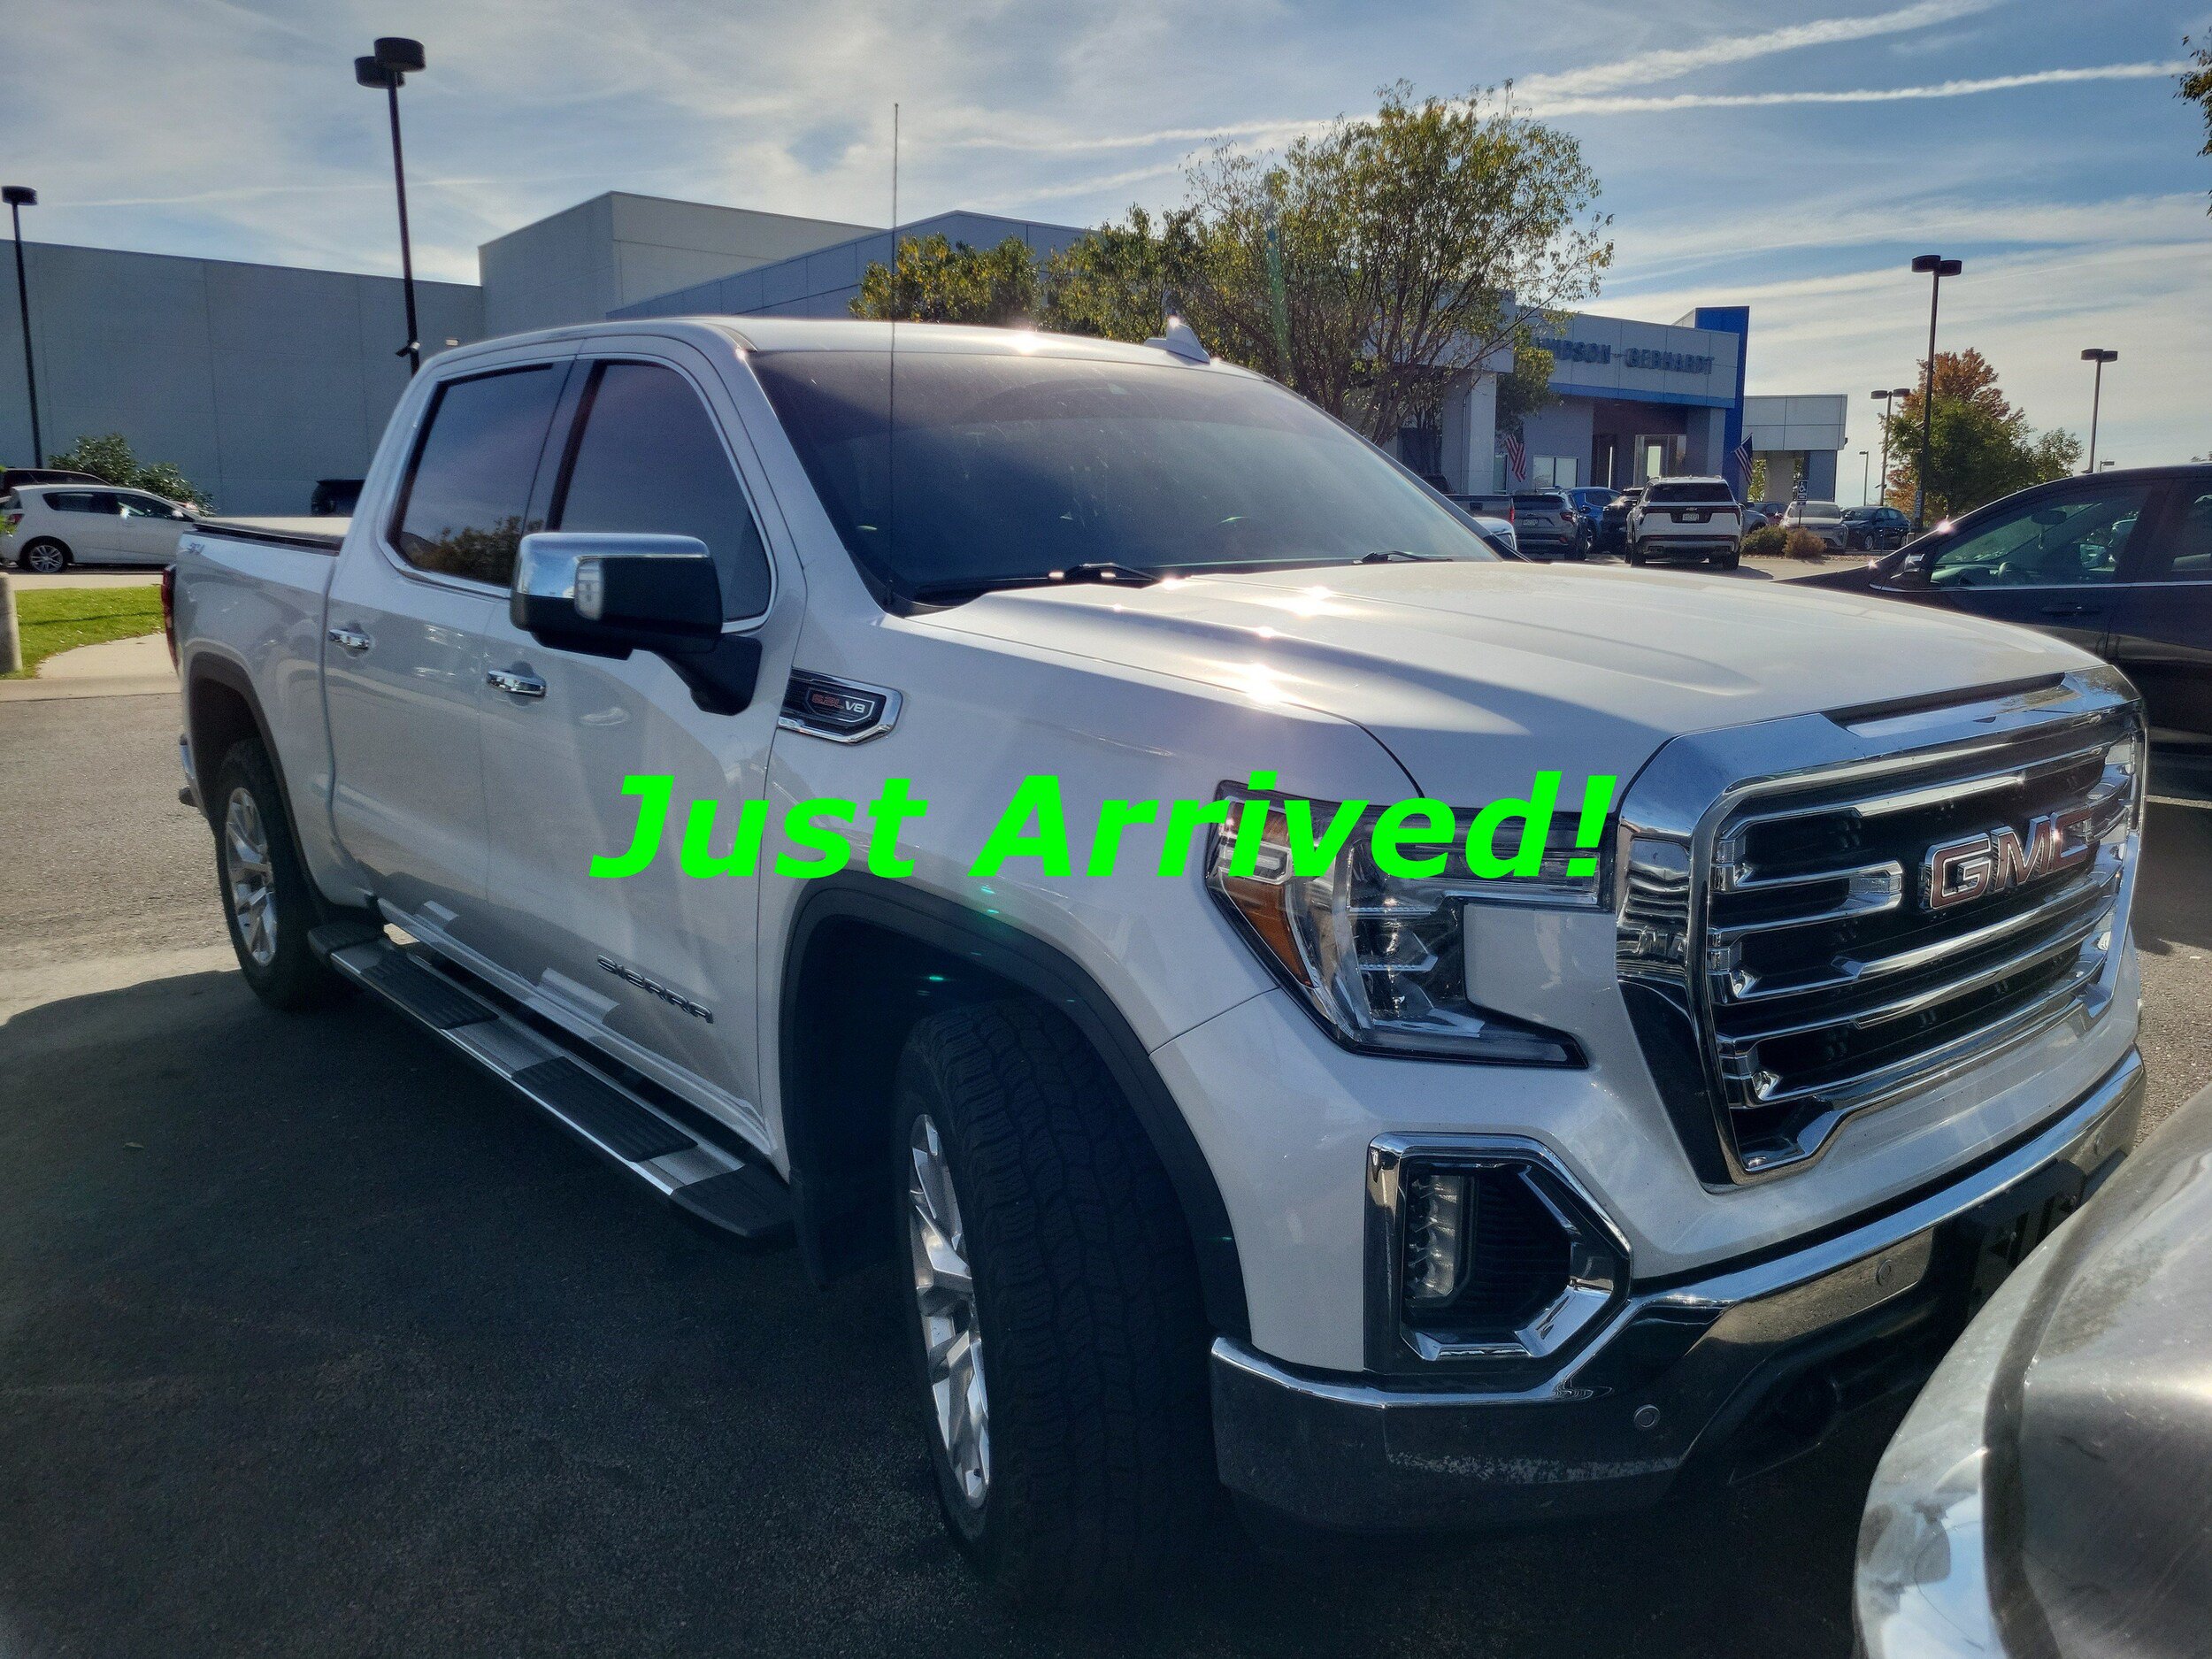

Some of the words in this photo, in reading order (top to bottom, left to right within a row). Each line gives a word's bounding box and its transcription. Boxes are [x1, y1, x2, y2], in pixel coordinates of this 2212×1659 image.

[845, 700, 866, 713] V8
[1923, 810, 2094, 910] GMC
[597, 954, 714, 1025] SIERRA
